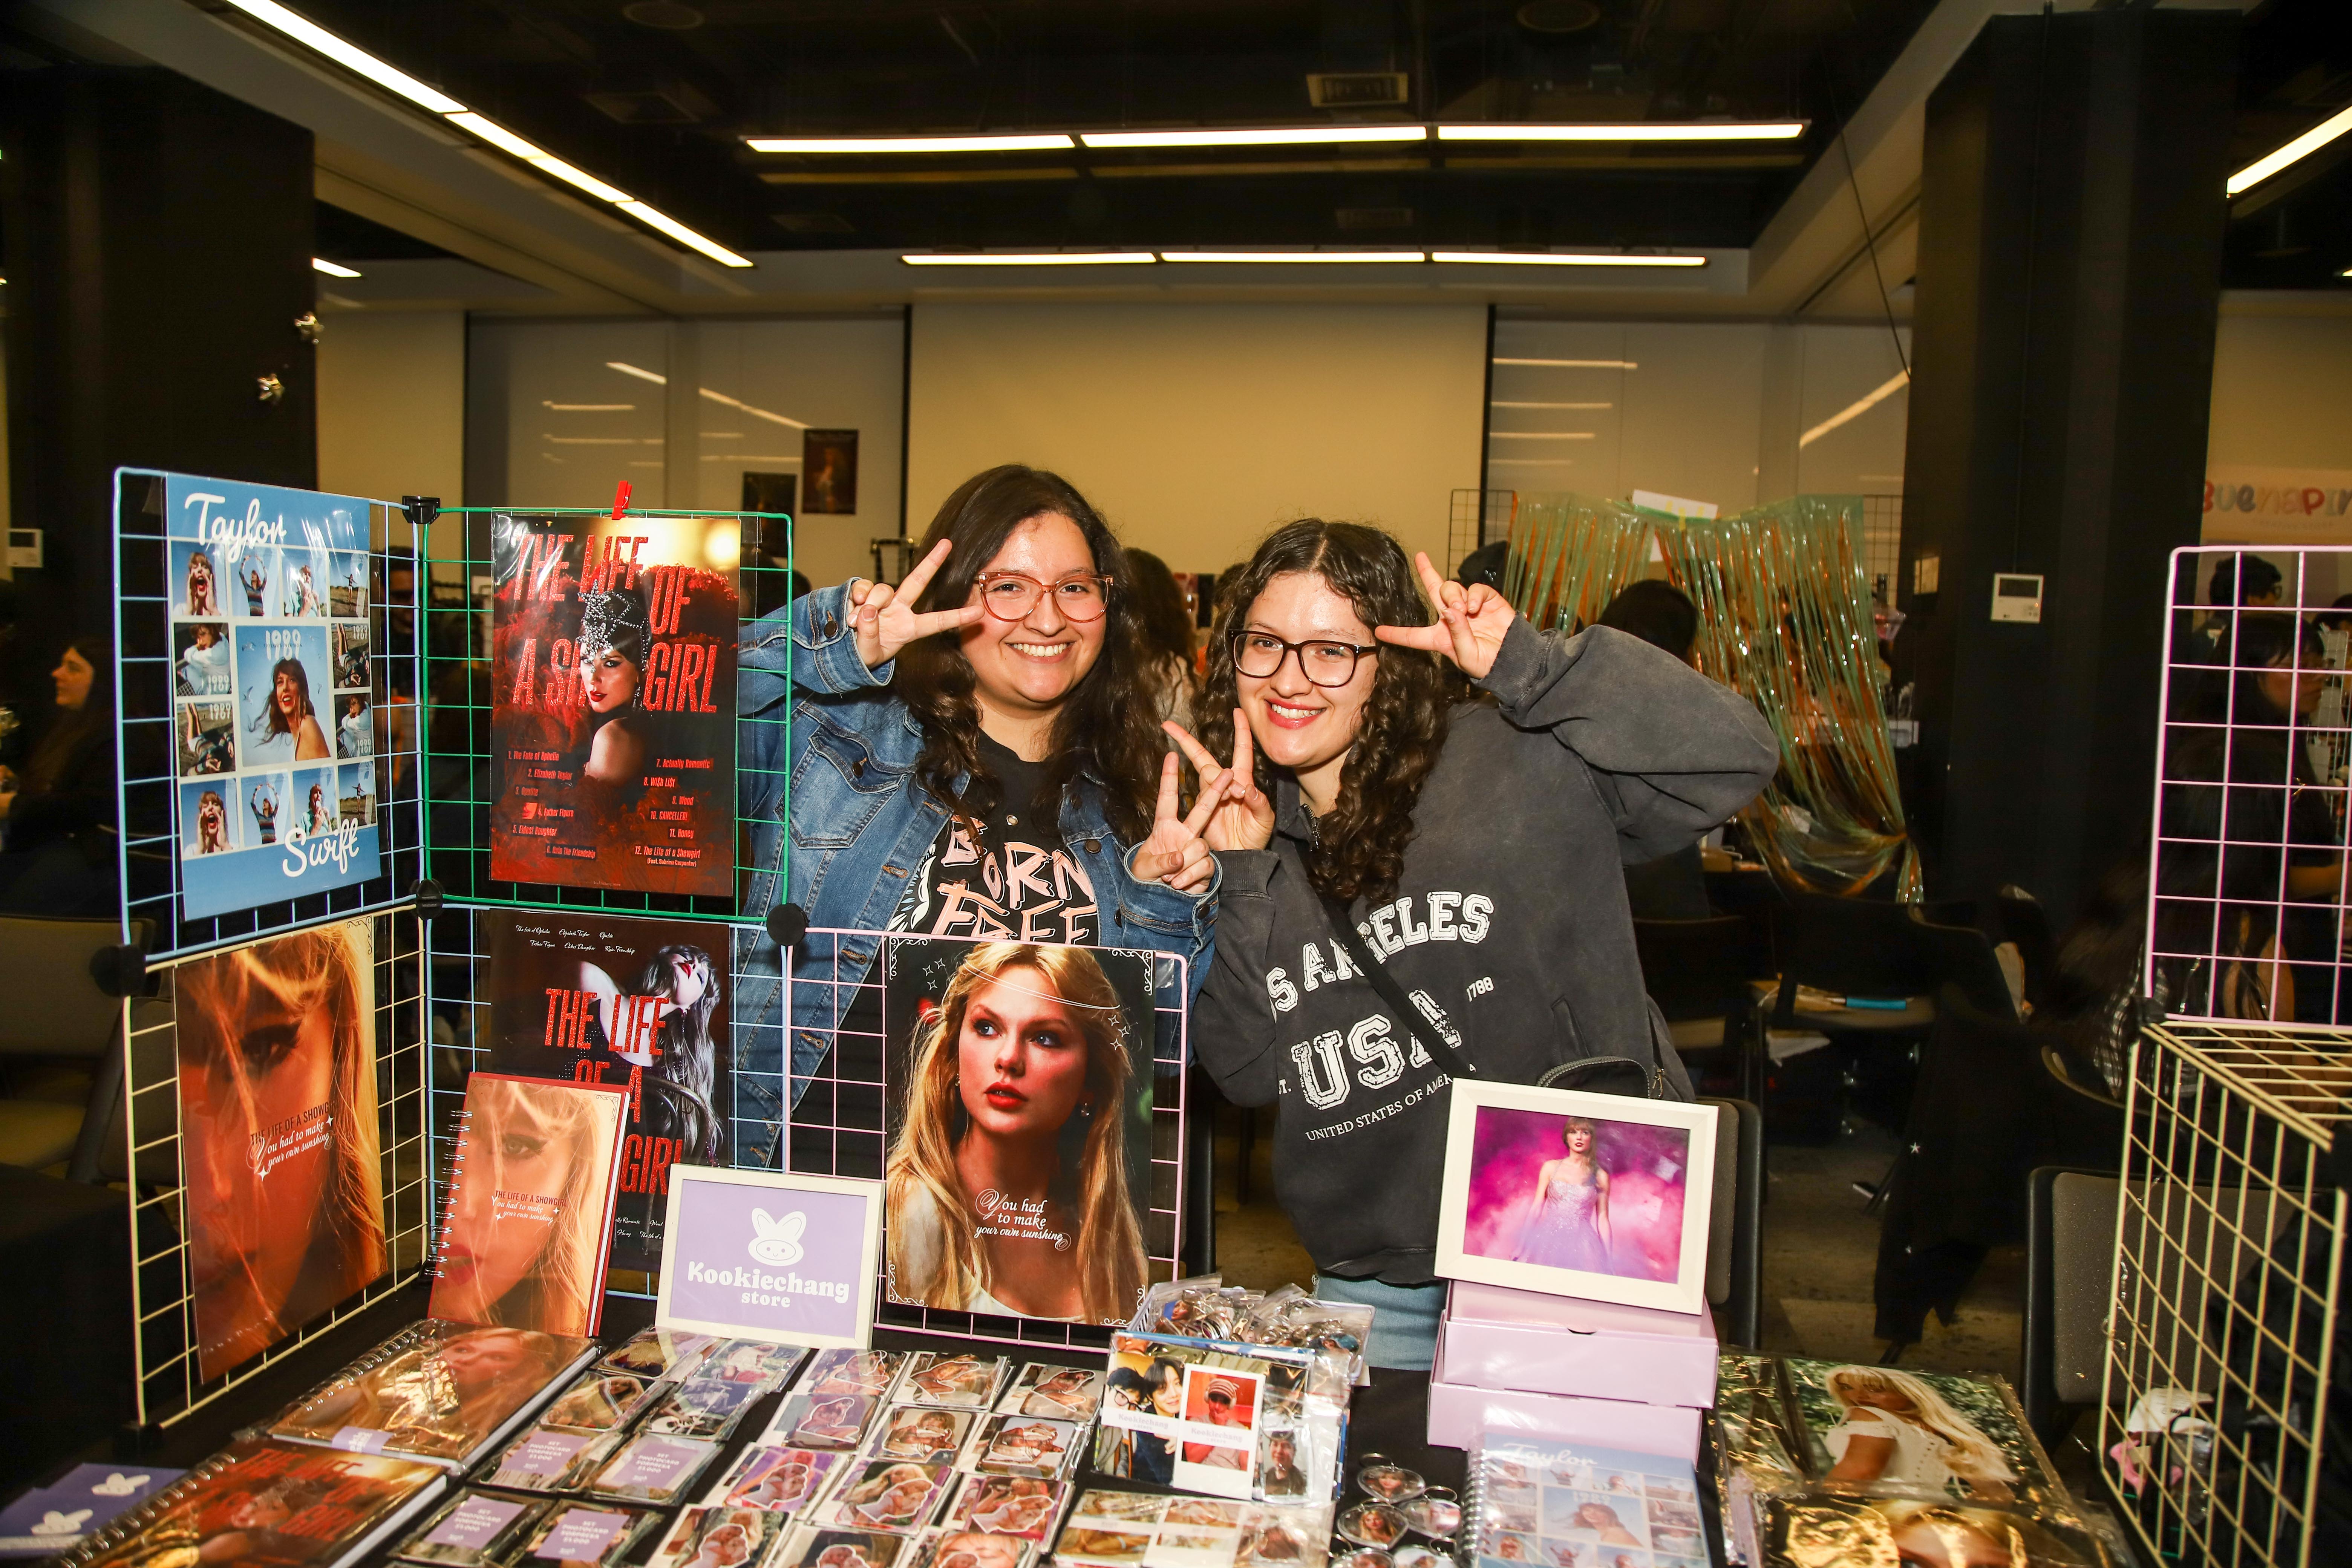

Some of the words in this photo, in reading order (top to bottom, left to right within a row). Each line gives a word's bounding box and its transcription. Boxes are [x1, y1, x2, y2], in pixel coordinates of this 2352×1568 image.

[185, 492, 287, 563] Taylor
[513, 533, 574, 601] THE
[649, 565, 695, 634] OF
[265, 629, 301, 661] 1989
[512, 639, 536, 705] A
[208, 675, 229, 692] 1989
[210, 702, 231, 720] 1989
[357, 738, 371, 754] 1989
[508, 751, 512, 760] 1.
[523, 751, 533, 760] Fate
[534, 752, 539, 760] of
[541, 752, 559, 761] Ophelia
[656, 759, 661, 767] 7.
[663, 759, 684, 769] Actually
[685, 759, 710, 769] Romantic
[528, 769, 532, 777] 2.
[534, 769, 556, 779] Elizabeth
[557, 771, 573, 780] Taylor
[644, 777, 649, 786] 8.
[651, 777, 664, 787] Wi$h
[665, 777, 675, 787] Li$t
[521, 787, 539, 796] Opalite
[672, 796, 677, 804] 9.
[679, 796, 694, 805] Wood
[544, 808, 557, 816] Father
[559, 808, 574, 818] Figure
[659, 811, 688, 820] CANCELLED!
[513, 824, 518, 833] 5.
[519, 825, 533, 834] Eldest
[535, 826, 557, 836] Daughter
[678, 828, 694, 839] Honey
[282, 817, 360, 877] Swift
[572, 847, 596, 859] Friendship
[643, 846, 653, 855] The
[654, 847, 664, 856] Life
[665, 848, 671, 856] of
[677, 848, 701, 859] Showgirl
[1466, 976, 1494, 1002] 1788
[544, 988, 598, 1049] THE
[608, 994, 670, 1055] LIFE
[1306, 1121, 1354, 1141] UNITED
[1355, 1101, 1403, 1128] STATES
[1405, 1088, 1423, 1106] OF
[268, 1121, 283, 1137] LIFE
[285, 1116, 294, 1131] OF
[296, 1114, 302, 1127] A
[246, 1135, 278, 1174] You
[279, 1130, 296, 1148] had
[296, 1131, 304, 1141] to
[305, 1119, 324, 1138] make
[268, 1153, 284, 1174] your
[286, 1146, 300, 1158] own
[301, 1130, 335, 1152] sunshine
[491, 1195, 505, 1207] You
[506, 1201, 519, 1209] had
[527, 1205, 544, 1214] make
[495, 1190, 507, 1199] THE
[507, 1192, 519, 1200] LIFE
[536, 1196, 567, 1207] SHOWGIRL
[975, 1188, 1017, 1220] You
[1021, 1198, 1048, 1213] had
[998, 1213, 1011, 1223] to
[1014, 1213, 1047, 1230] make
[617, 1229, 631, 1237] Honey
[974, 1226, 998, 1239] your
[1000, 1228, 1020, 1237] own
[1021, 1229, 1072, 1251] sunshine
[688, 1261, 850, 1303] Kookiechang
[741, 1291, 791, 1308] store
[1118, 1413, 1169, 1429] Kookiechang
[1191, 1427, 1243, 1443] Kookiechang
[1504, 1442, 1598, 1467] Taylor
